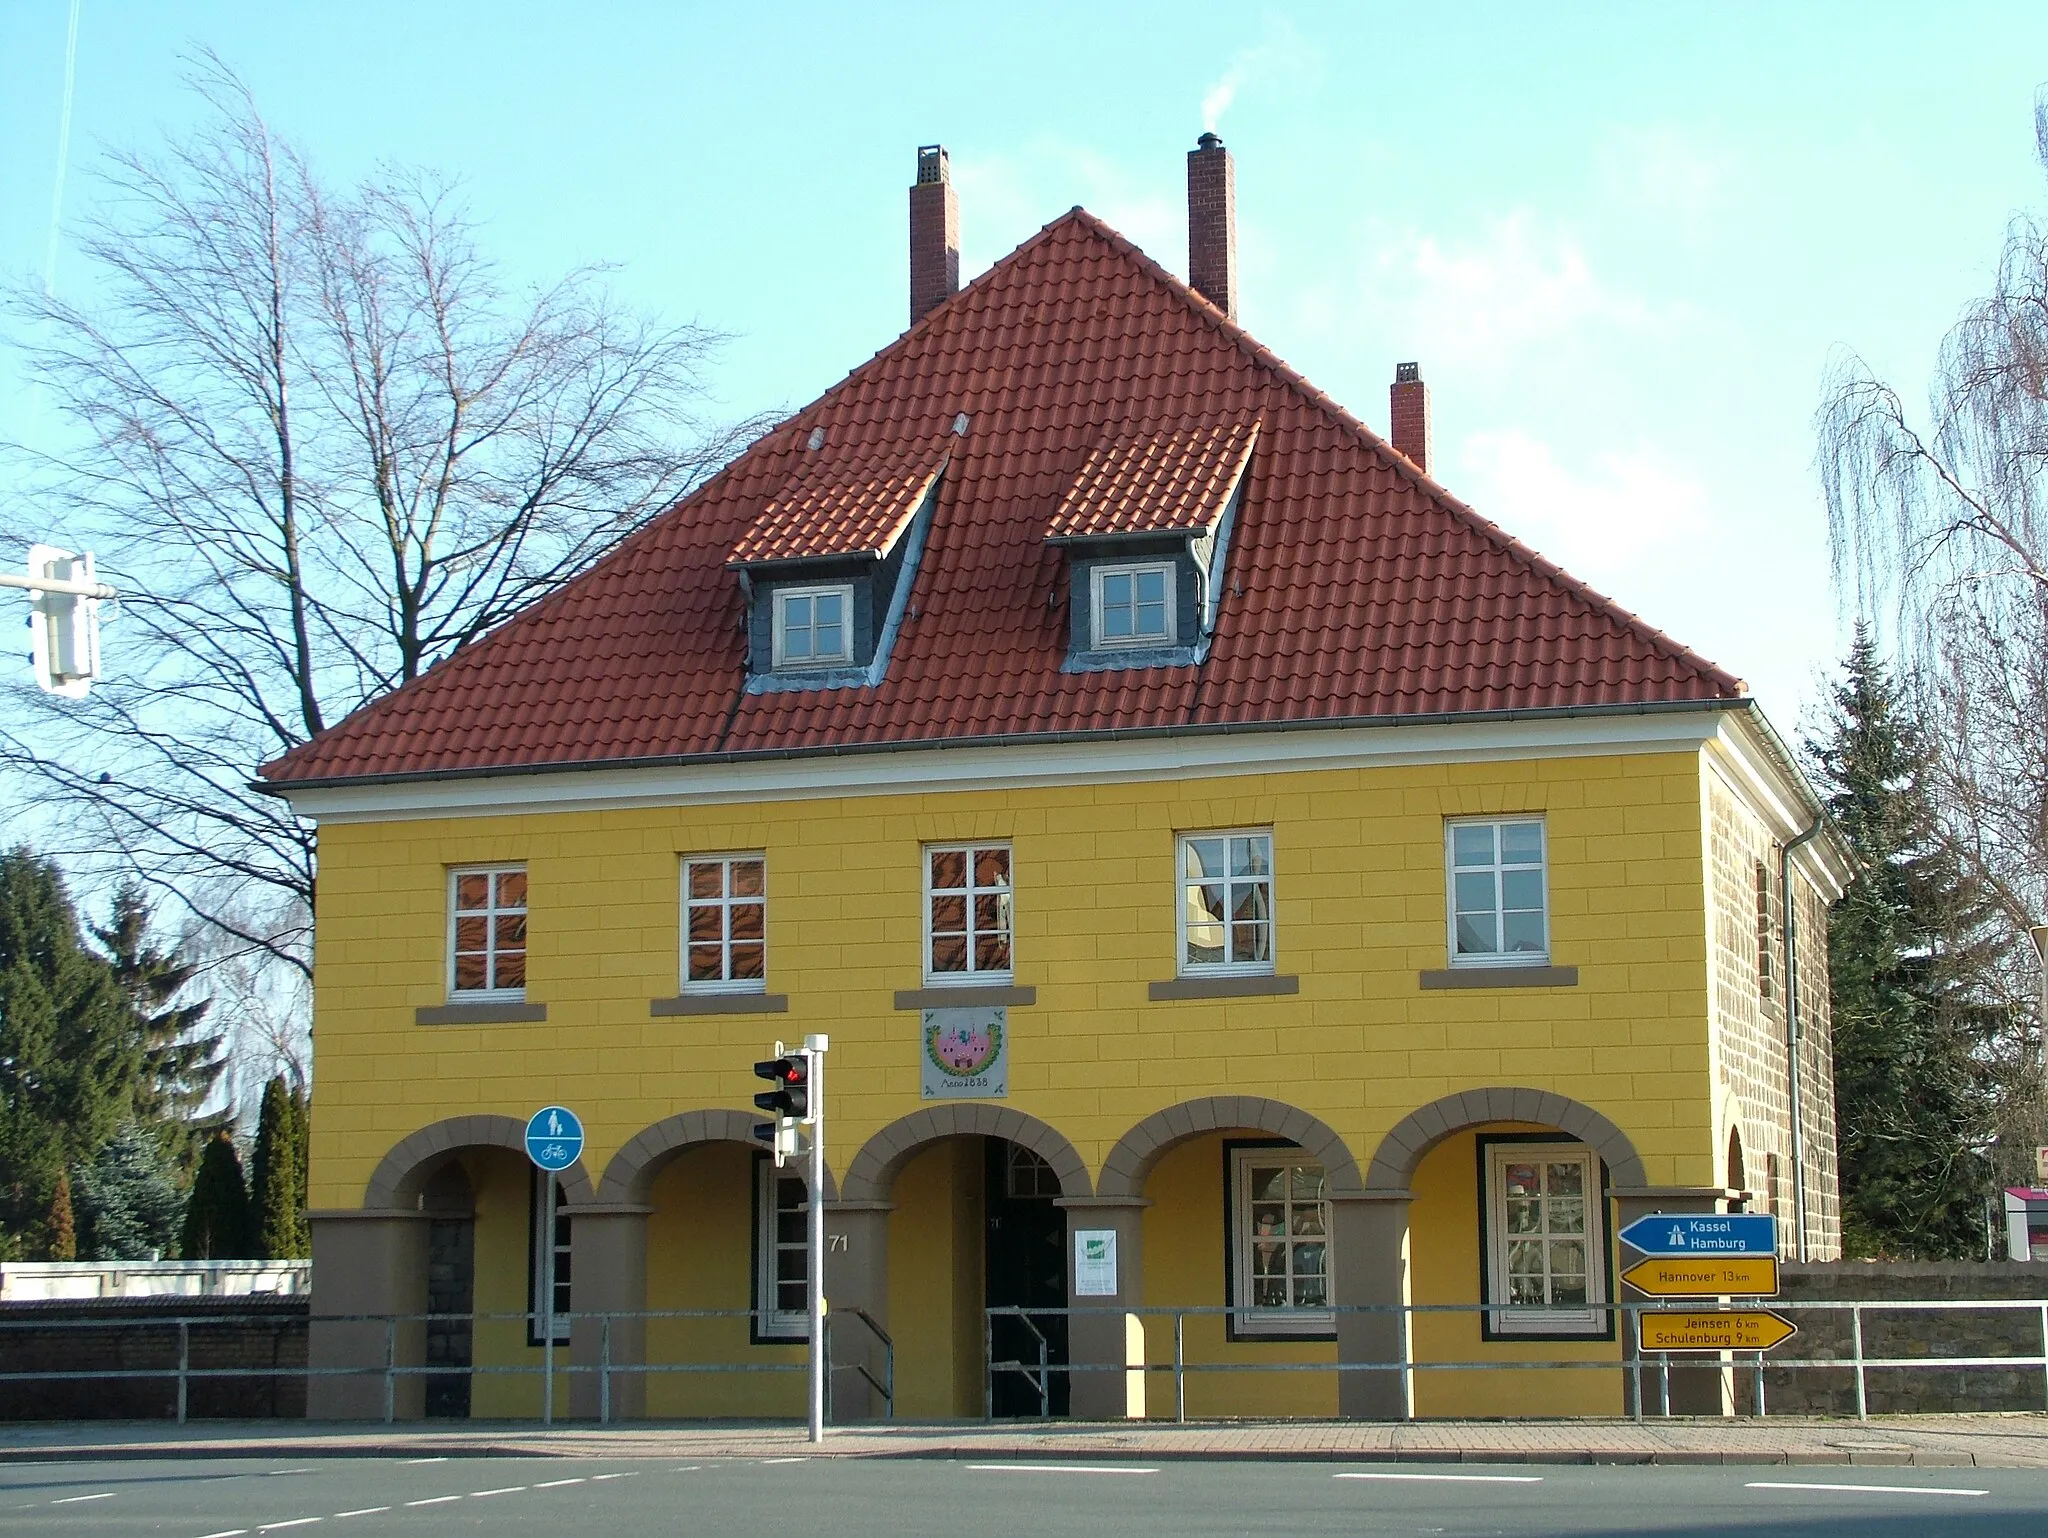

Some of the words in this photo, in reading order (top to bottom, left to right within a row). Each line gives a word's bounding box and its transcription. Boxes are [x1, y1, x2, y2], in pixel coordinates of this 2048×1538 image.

[1690, 1221, 1731, 1232] Kassel
[828, 1234, 848, 1252] 71
[1691, 1238, 1746, 1250] Hamburg
[1659, 1271, 1717, 1282] Hannover
[1723, 1271, 1734, 1281] 13
[1736, 1273, 1750, 1281] km
[1684, 1318, 1731, 1329] Jeinsen
[1736, 1318, 1742, 1328] 6
[1745, 1320, 1759, 1328] km
[1656, 1332, 1731, 1345] Schulenburg
[1736, 1332, 1743, 1344] 9
[1745, 1335, 1760, 1343] km
